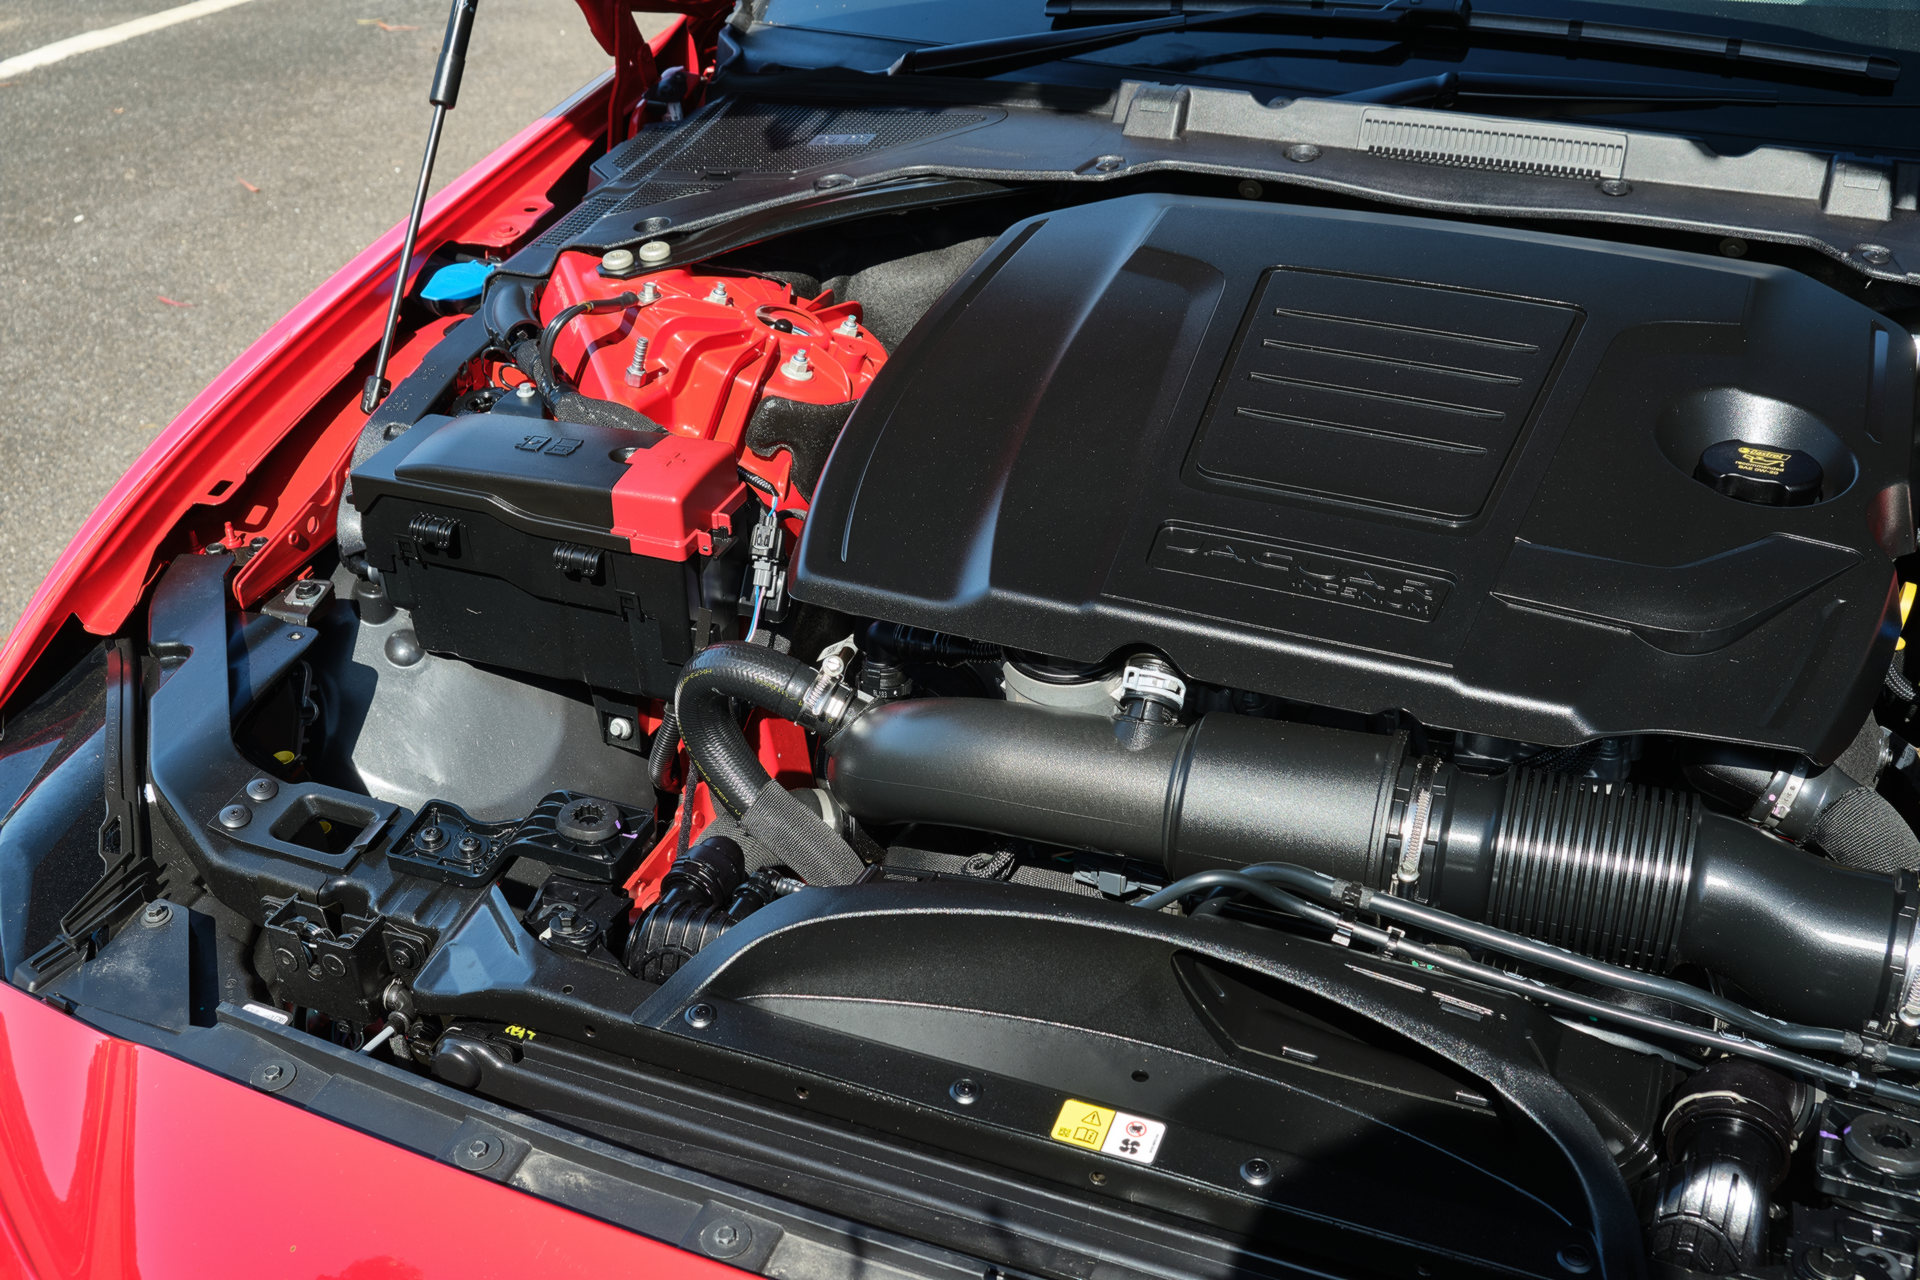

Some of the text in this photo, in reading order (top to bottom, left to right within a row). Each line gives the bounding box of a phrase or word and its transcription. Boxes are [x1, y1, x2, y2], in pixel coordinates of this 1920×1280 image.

[1749, 449, 1783, 459] Castrol
[1735, 461, 1785, 472] recommended
[1166, 543, 1433, 601] JAGUAR
